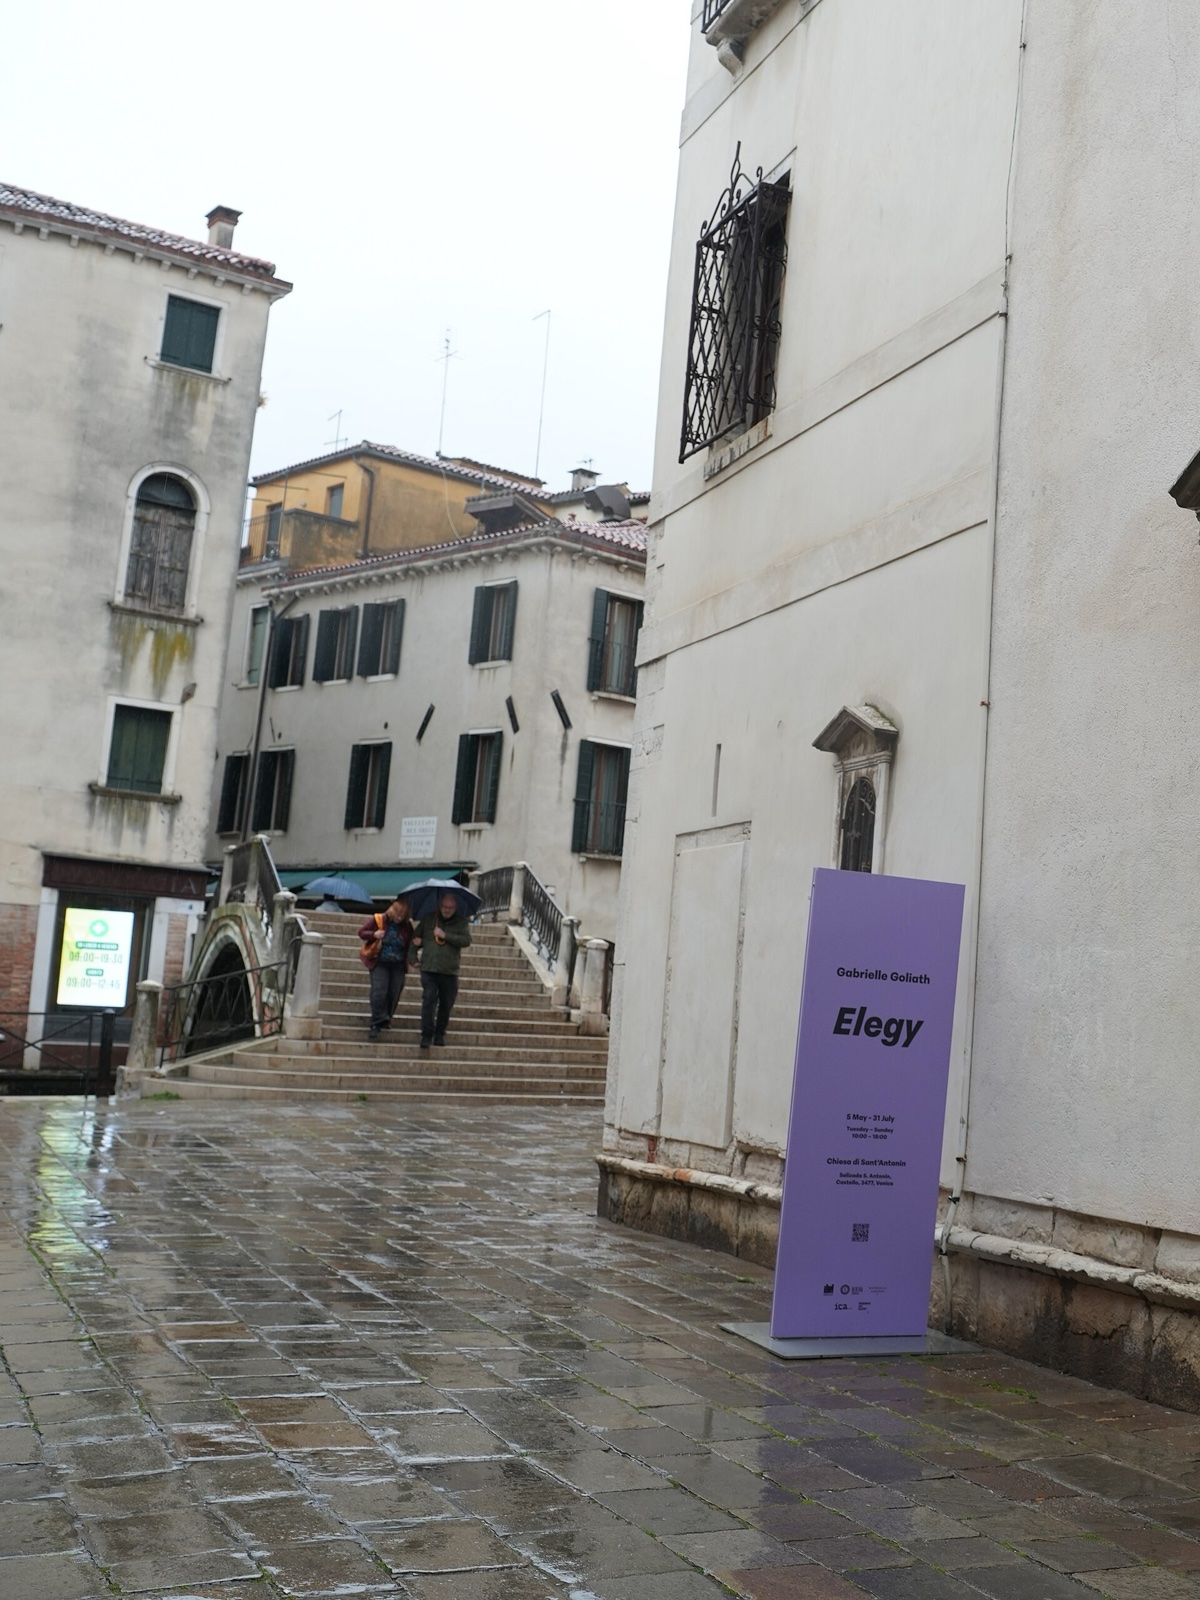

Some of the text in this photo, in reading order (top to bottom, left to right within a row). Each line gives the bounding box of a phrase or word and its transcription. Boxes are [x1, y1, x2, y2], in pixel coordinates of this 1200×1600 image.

[836, 966, 931, 985] Gabrielle Goliath
[832, 1006, 925, 1048] Elegy
[852, 1114, 867, 1122] May
[881, 1115, 895, 1123] July
[826, 1157, 907, 1167] Chiesa di Sant'Antonin
